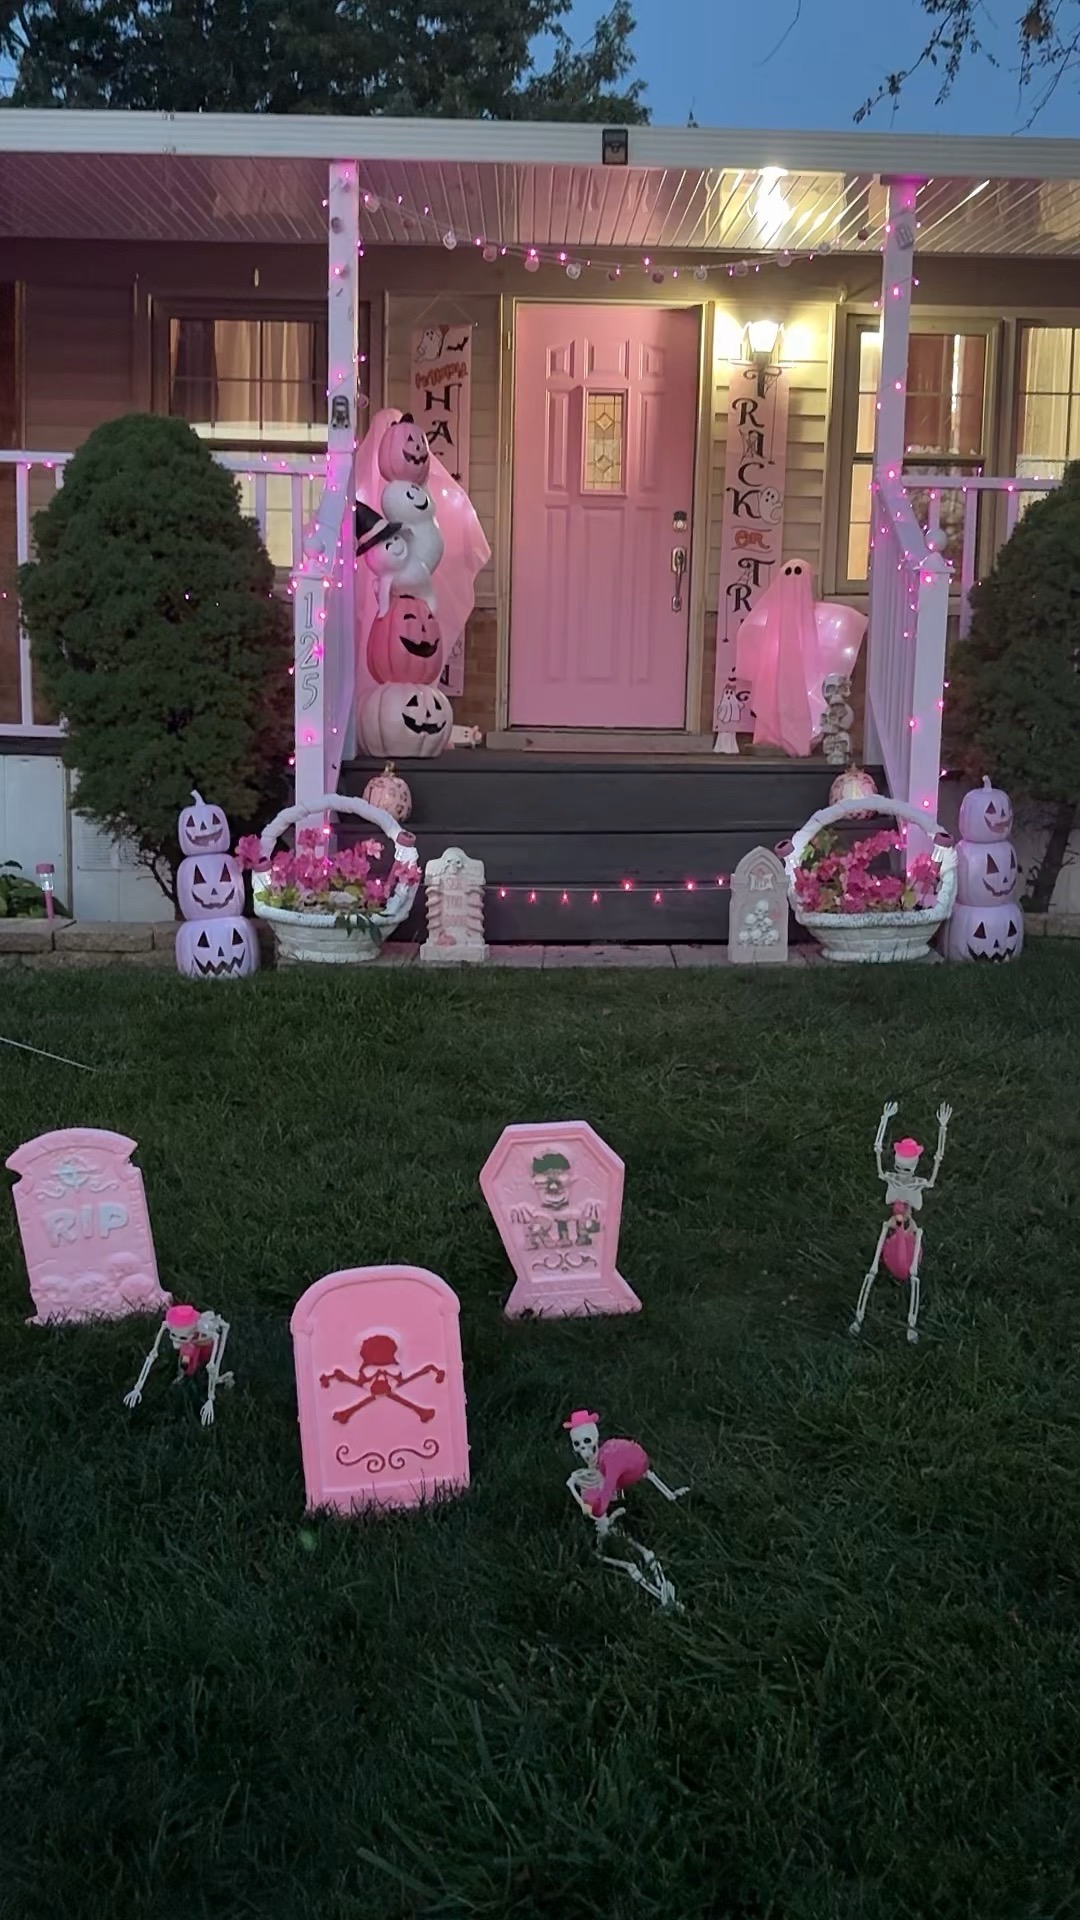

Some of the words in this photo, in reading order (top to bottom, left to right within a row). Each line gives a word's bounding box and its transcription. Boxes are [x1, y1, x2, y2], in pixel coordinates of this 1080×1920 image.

[726, 366, 783, 519] TRICK
[734, 529, 771, 550] OR
[300, 592, 320, 711] 125
[43, 1202, 129, 1248] RIP
[525, 1214, 602, 1251] RIP
